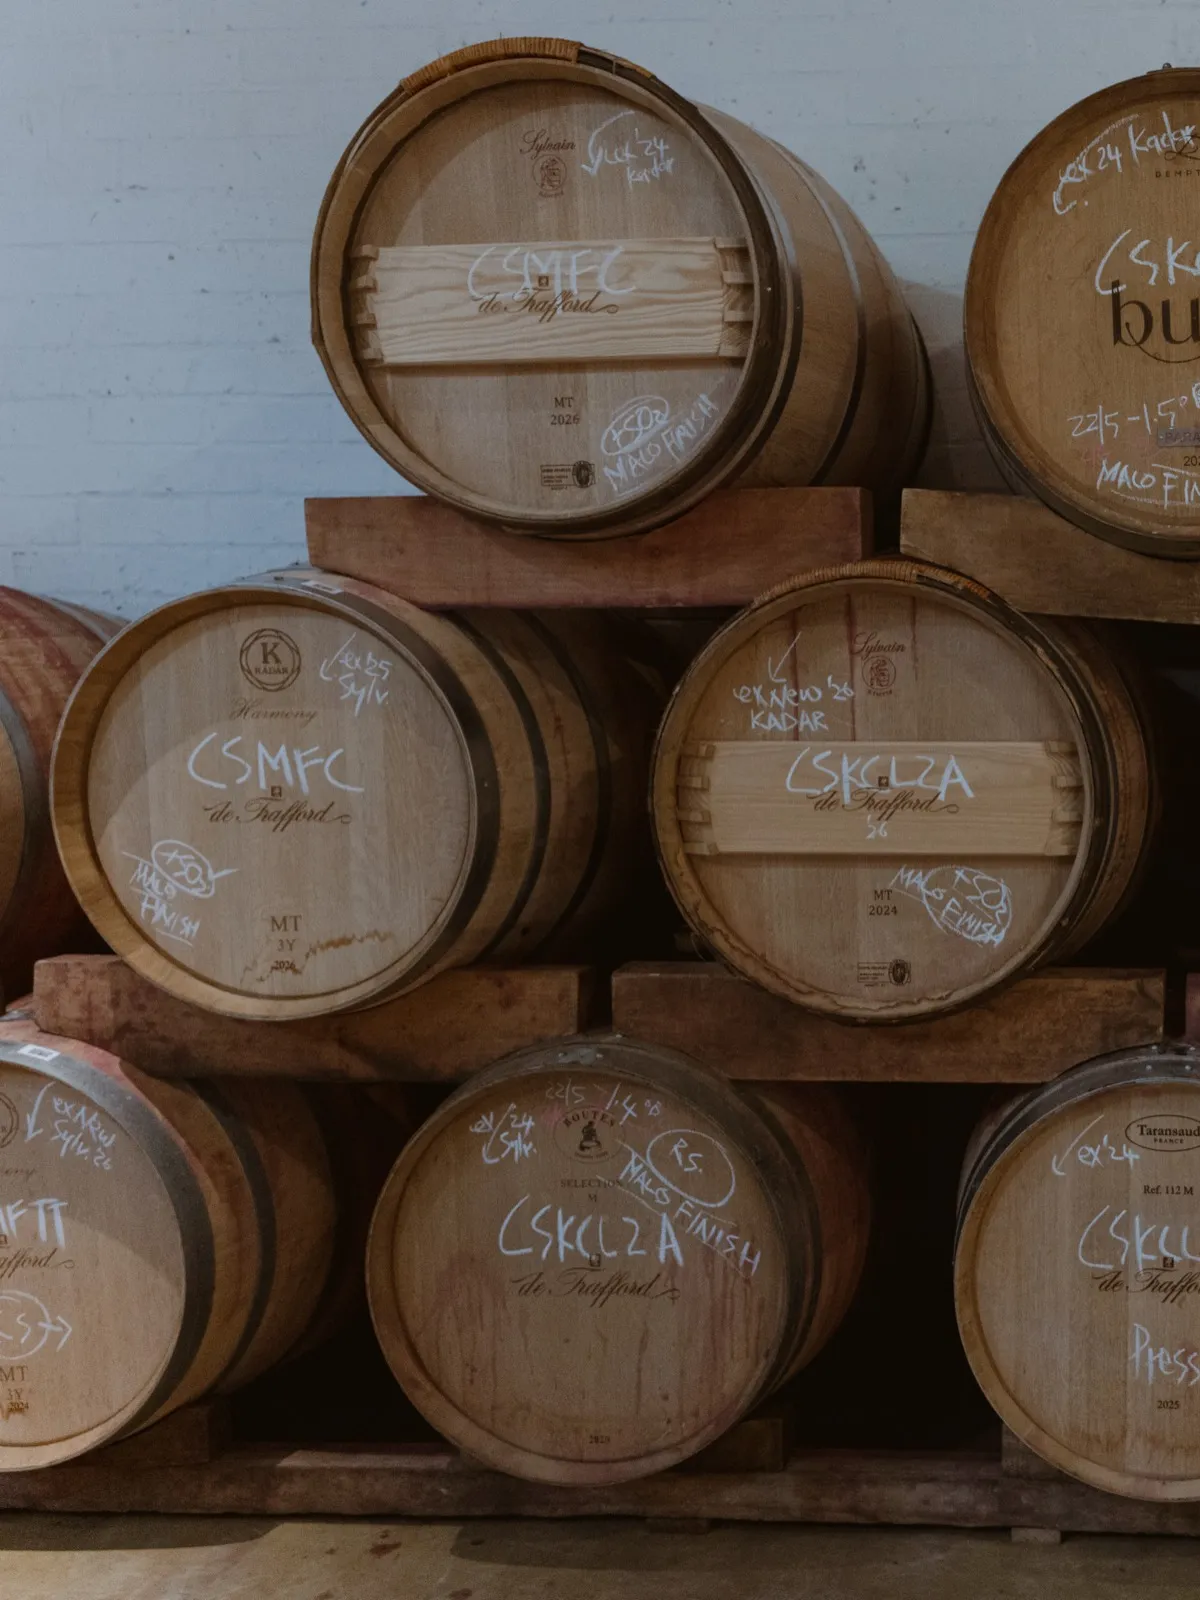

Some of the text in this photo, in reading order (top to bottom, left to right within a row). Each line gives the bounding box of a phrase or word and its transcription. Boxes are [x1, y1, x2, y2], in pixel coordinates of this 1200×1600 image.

[519, 128, 577, 160] Sylvain
[477, 288, 620, 324] de Trafford
[554, 397, 573, 408] MT
[550, 414, 580, 425] 2026
[260, 642, 282, 665] K
[852, 631, 906, 656] Sylvain
[228, 698, 318, 727] Harmony
[750, 711, 830, 733] KADAR
[187, 732, 366, 796] CSMFC
[202, 797, 353, 833] de Trafford
[807, 788, 959, 821] de Trafford
[873, 889, 893, 901] MT
[868, 905, 898, 916] 2024
[270, 914, 302, 933] MT
[1143, 1184, 1195, 1196] Ref. 112 M
[672, 1199, 761, 1277] FINISH
[510, 1266, 681, 1309] de Trafford
[1090, 1270, 1124, 1294] de
[1156, 1400, 1181, 1411] 2025
